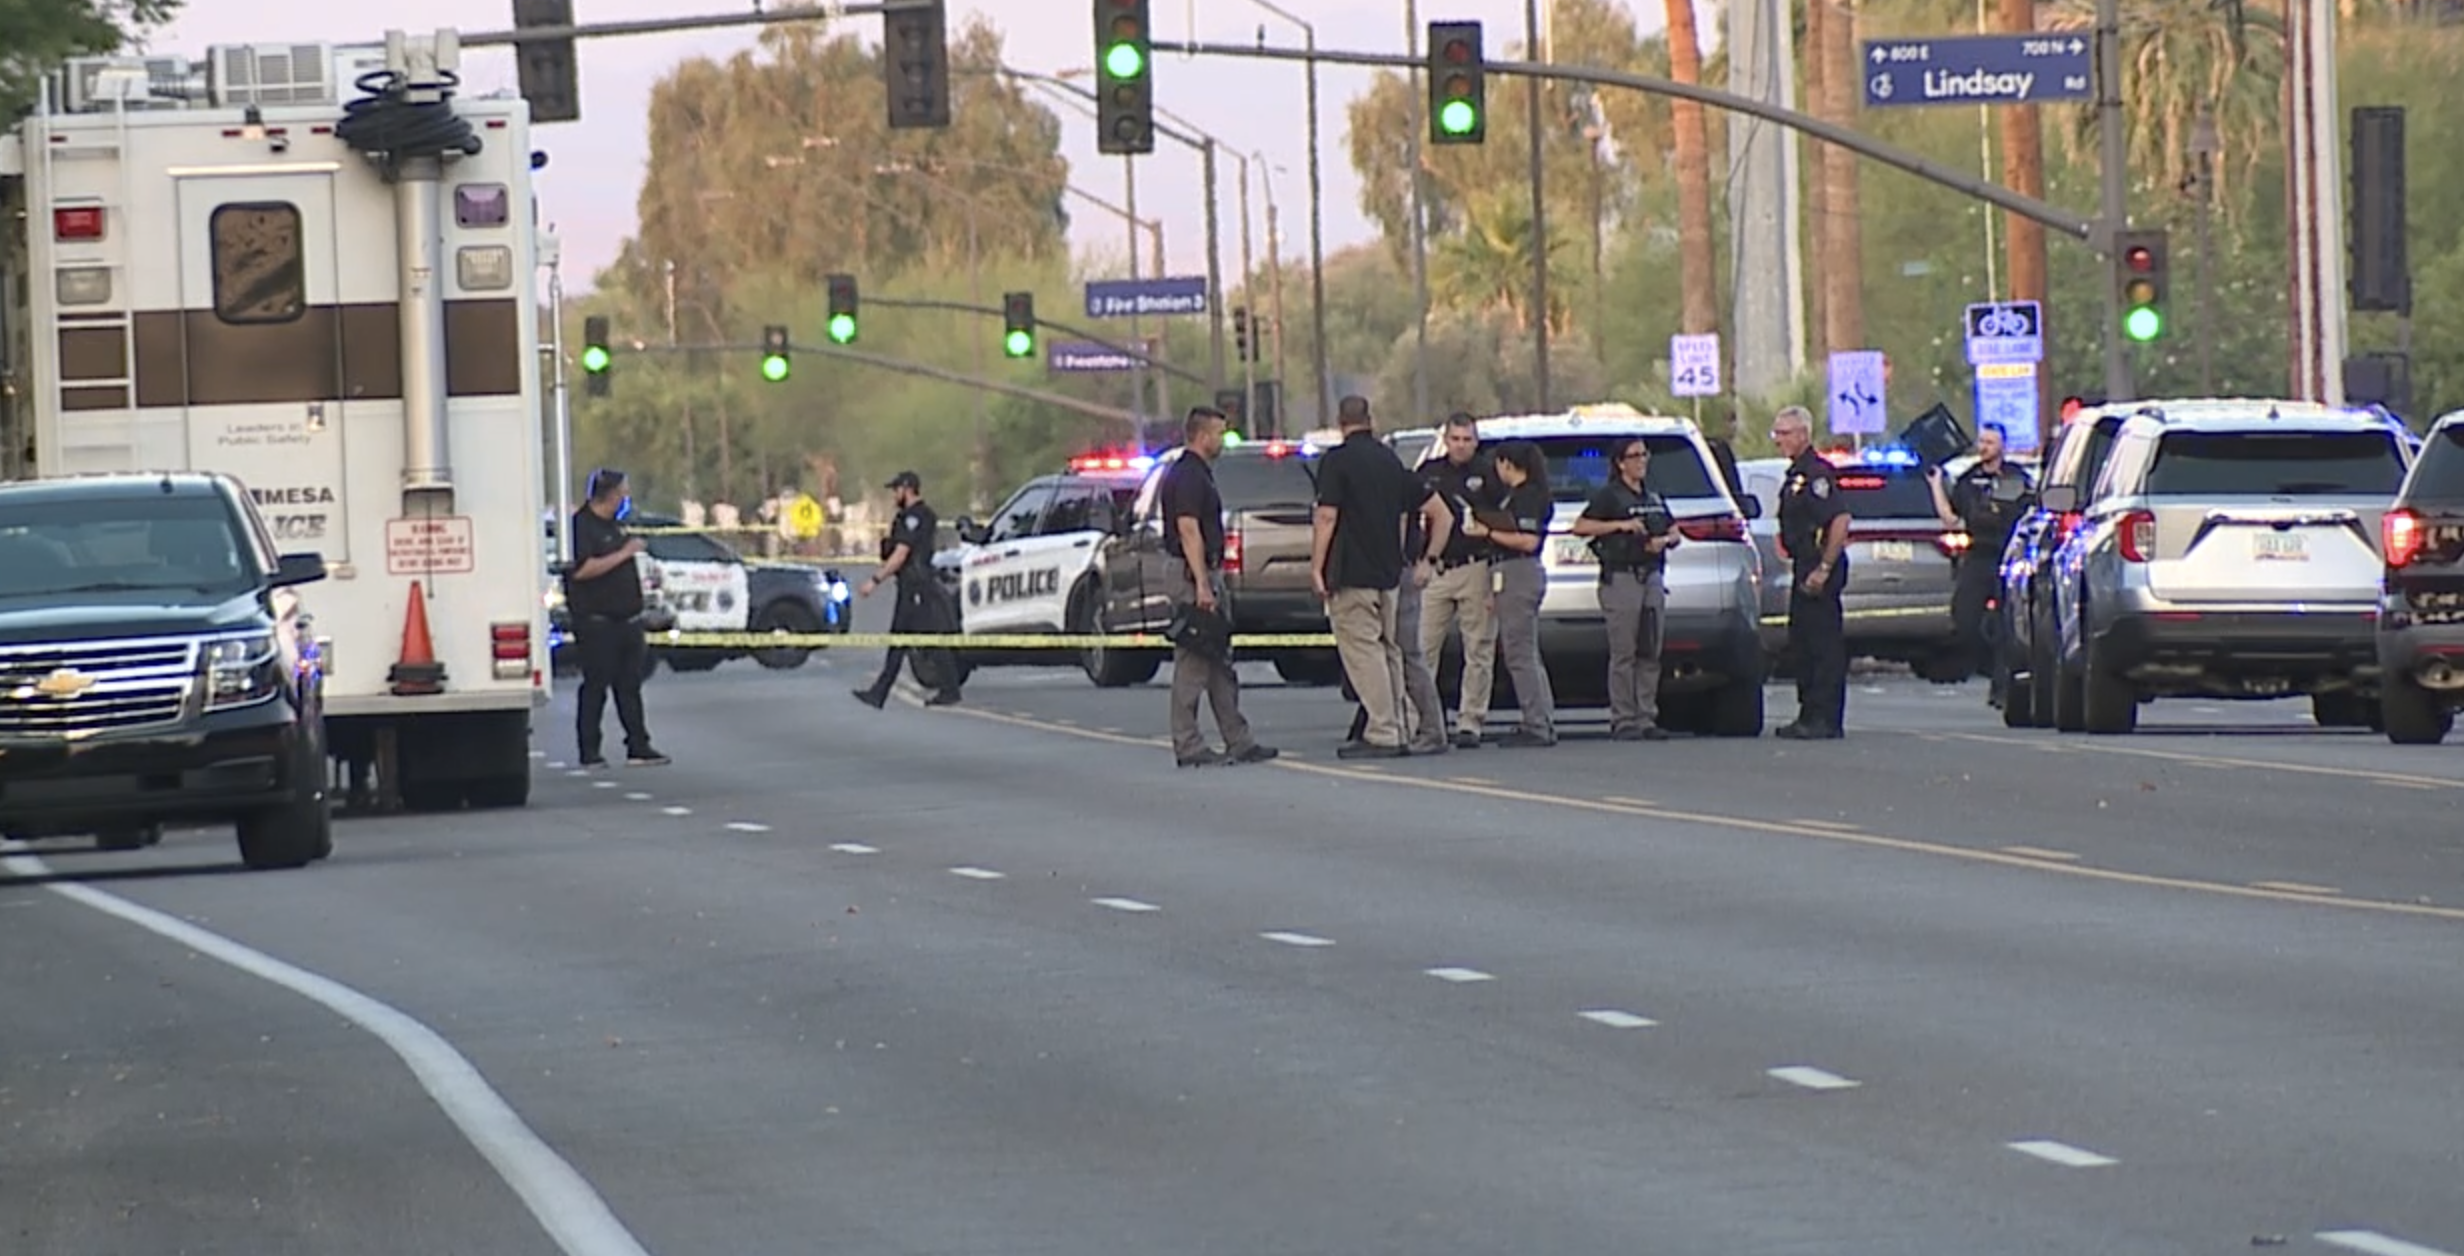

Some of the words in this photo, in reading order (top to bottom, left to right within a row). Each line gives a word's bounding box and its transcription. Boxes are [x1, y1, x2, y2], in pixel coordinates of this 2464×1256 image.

[1890, 46, 1918, 61] 800
[1919, 45, 1929, 60] E
[2022, 41, 2049, 56] 700
[2051, 40, 2065, 54] N
[1923, 67, 2034, 99] Lindsay
[2064, 75, 2086, 90] Rd
[1677, 366, 1715, 387] 45
[226, 423, 285, 434] Leaders
[289, 423, 301, 432] in
[218, 436, 261, 446] Public
[266, 435, 311, 446] Safety
[265, 487, 335, 505] MESA
[270, 514, 326, 540] ICE
[987, 566, 1060, 604] POLICE
